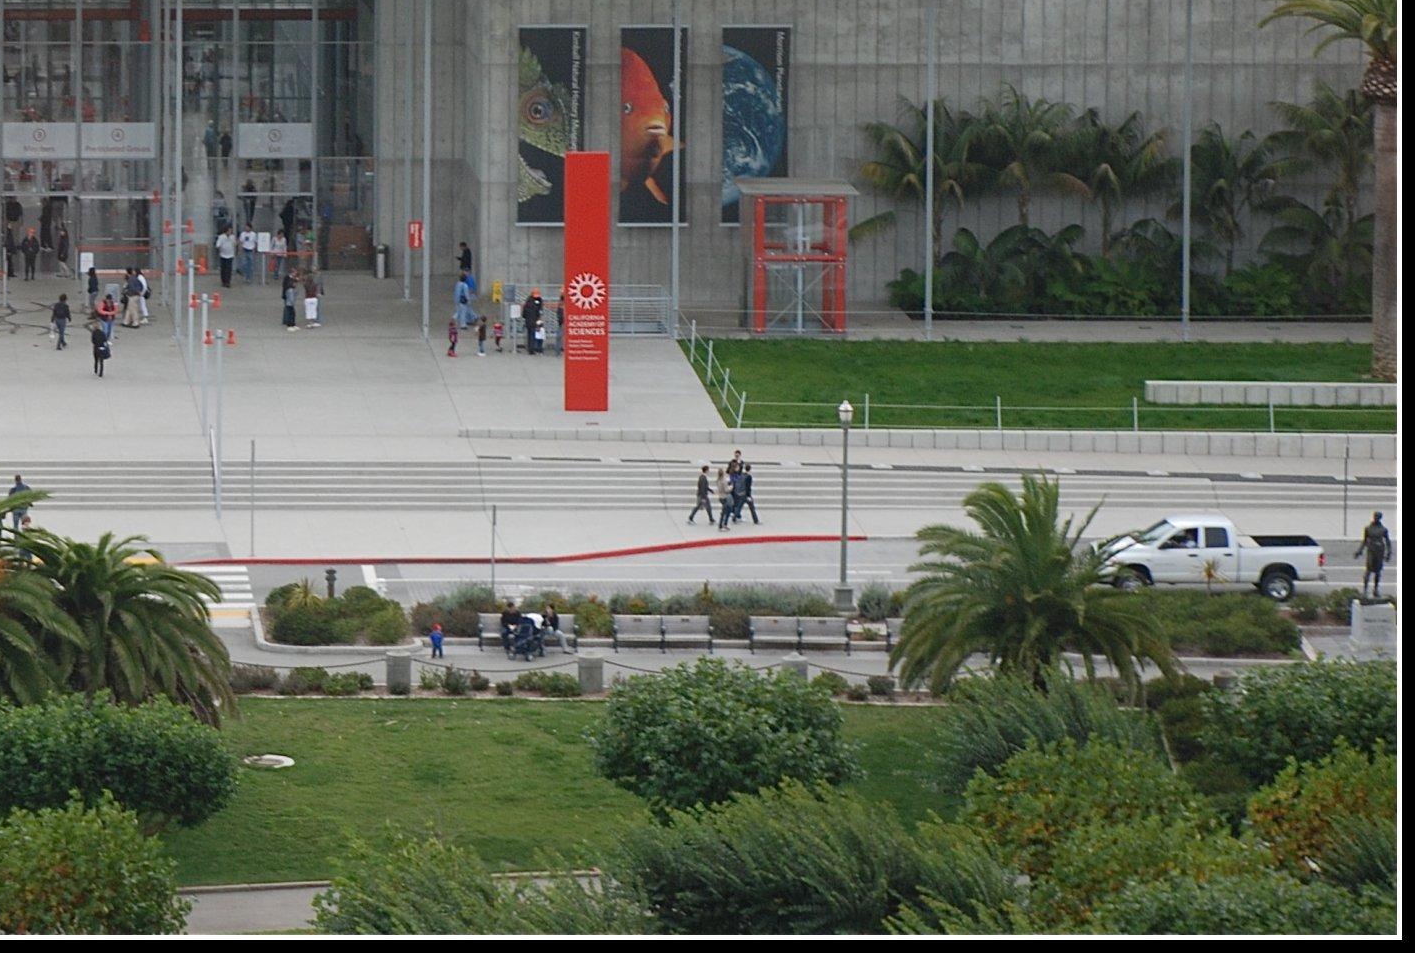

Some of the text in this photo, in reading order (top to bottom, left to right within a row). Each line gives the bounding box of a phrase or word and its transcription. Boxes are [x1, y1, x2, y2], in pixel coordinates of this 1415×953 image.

[571, 61, 580, 89] Natural
[570, 90, 580, 118] History
[568, 328, 605, 336] SCIENCES
